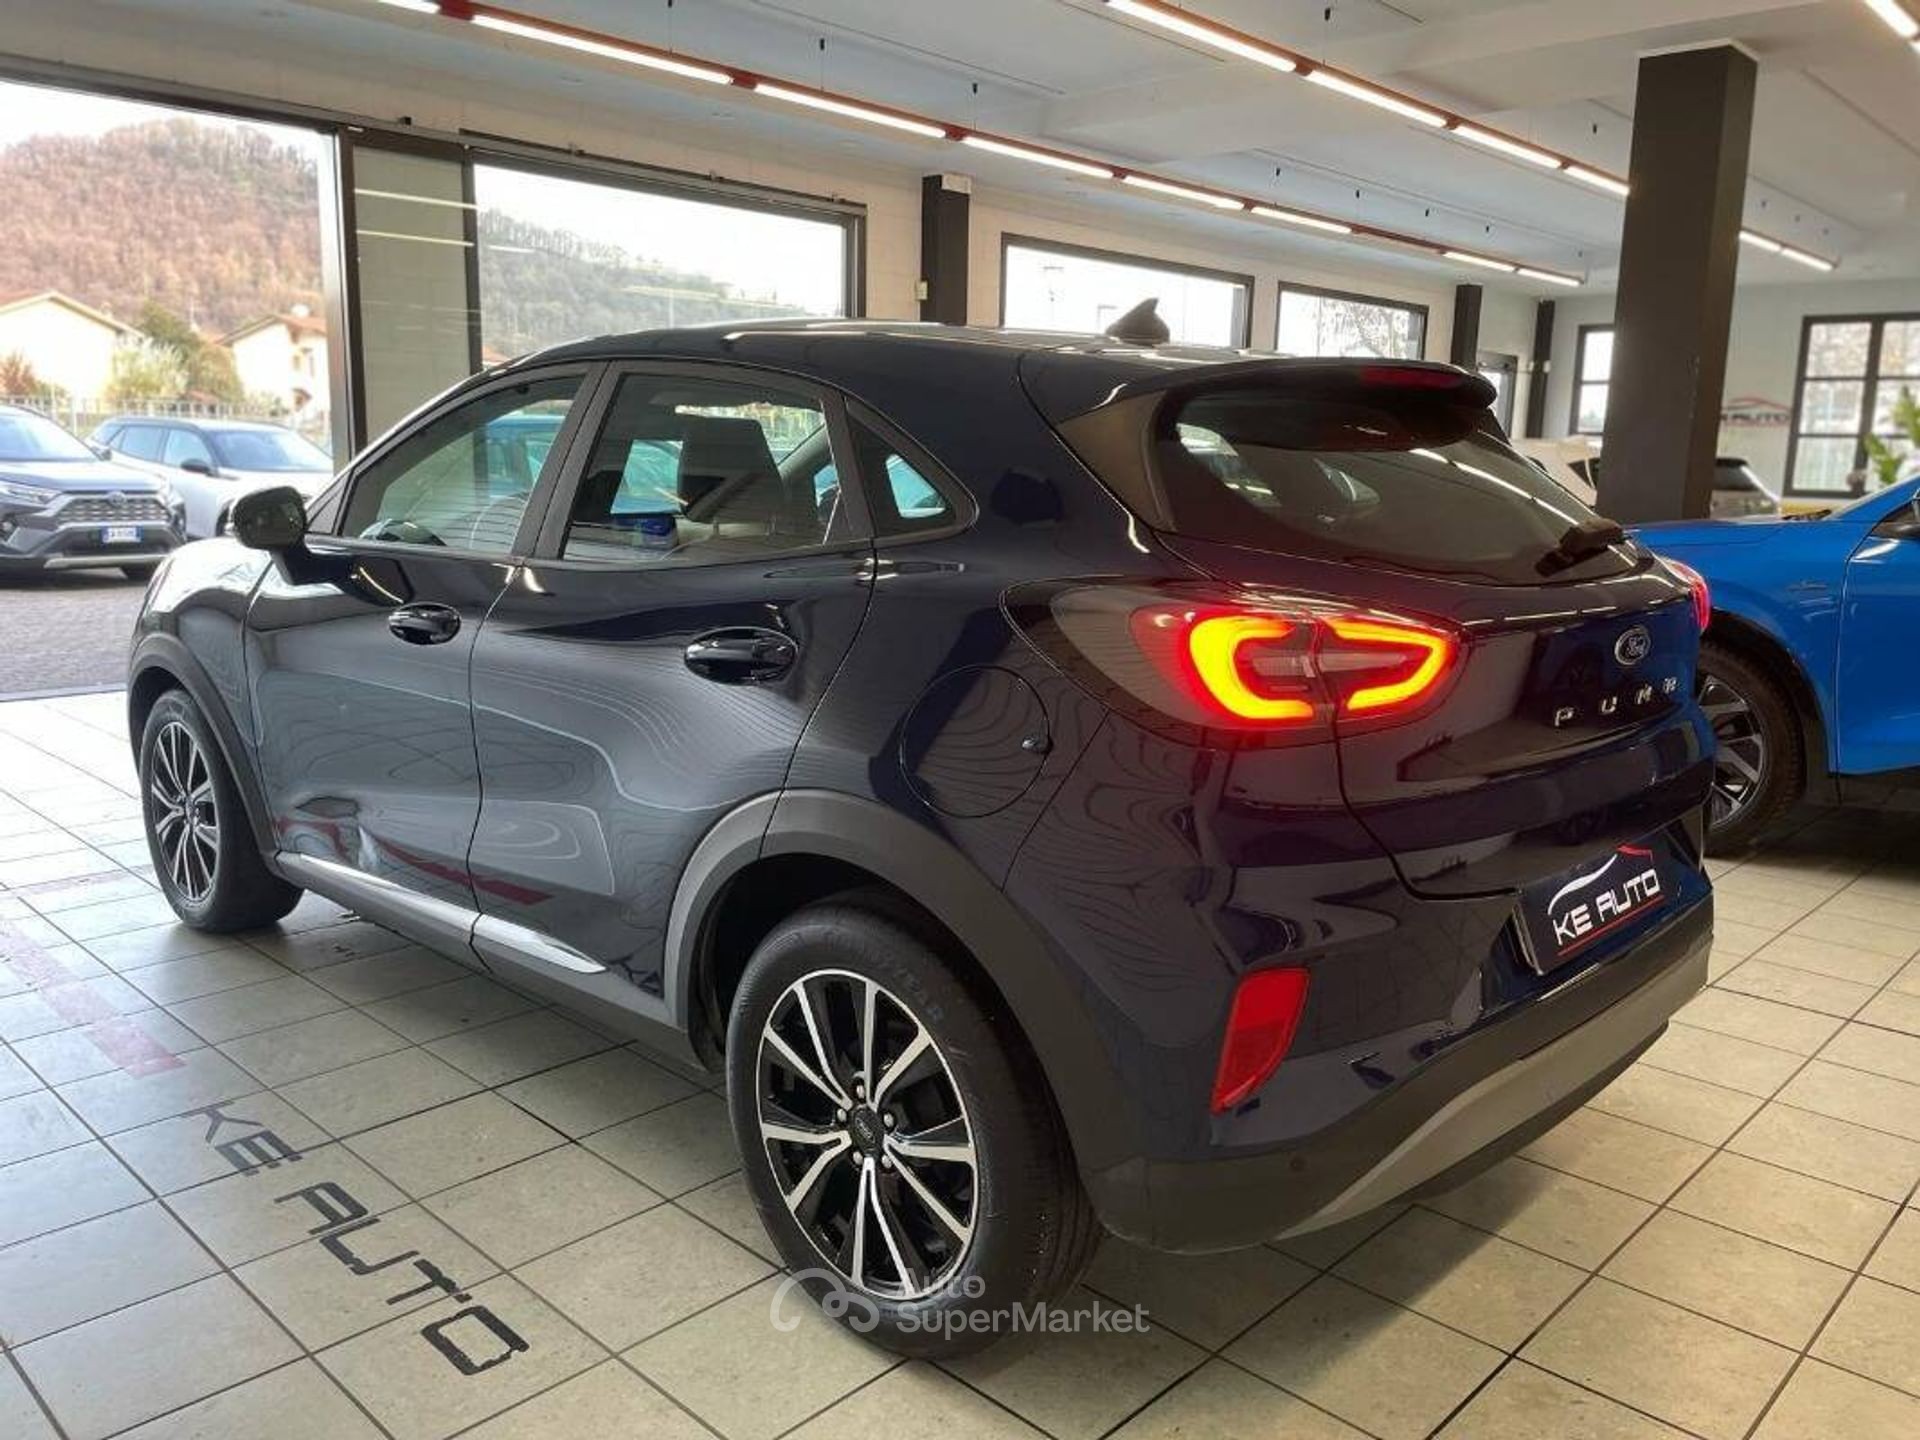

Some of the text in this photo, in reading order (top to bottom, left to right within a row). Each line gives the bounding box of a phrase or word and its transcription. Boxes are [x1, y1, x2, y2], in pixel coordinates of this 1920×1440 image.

[1552, 868, 1661, 946] KE AUTO
[182, 1099, 531, 1376] KE AUTO
